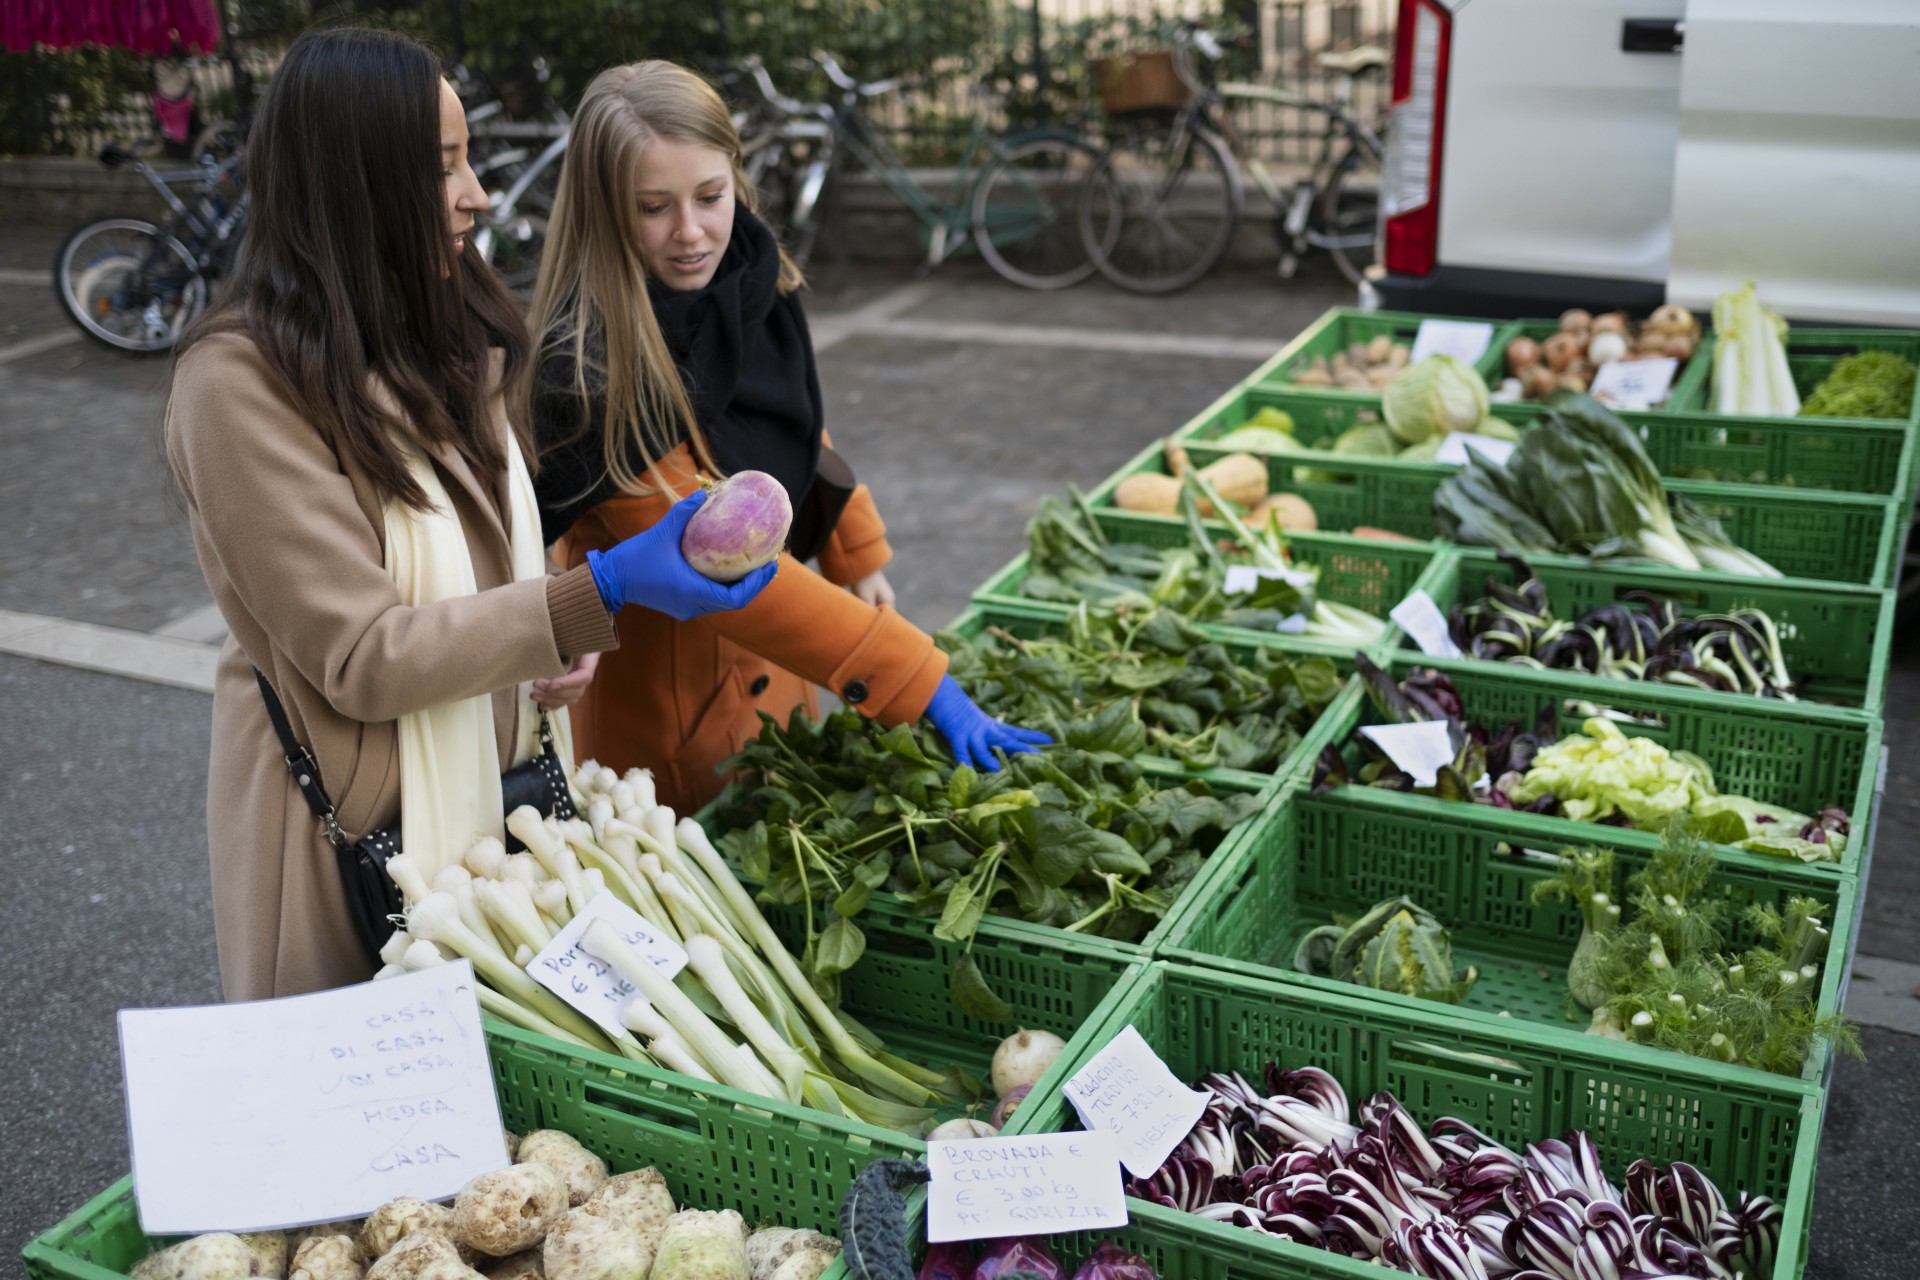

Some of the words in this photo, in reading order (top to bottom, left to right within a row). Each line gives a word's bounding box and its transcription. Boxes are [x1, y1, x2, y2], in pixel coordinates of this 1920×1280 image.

[370, 1142, 461, 1172] CASA
[942, 1144, 1056, 1165] BROVADA
[953, 1161, 1048, 1183] CRAUTI
[956, 1190, 976, 1206] €
[1050, 1180, 1078, 1200] kg
[1009, 1204, 1111, 1222] GORIZIA
